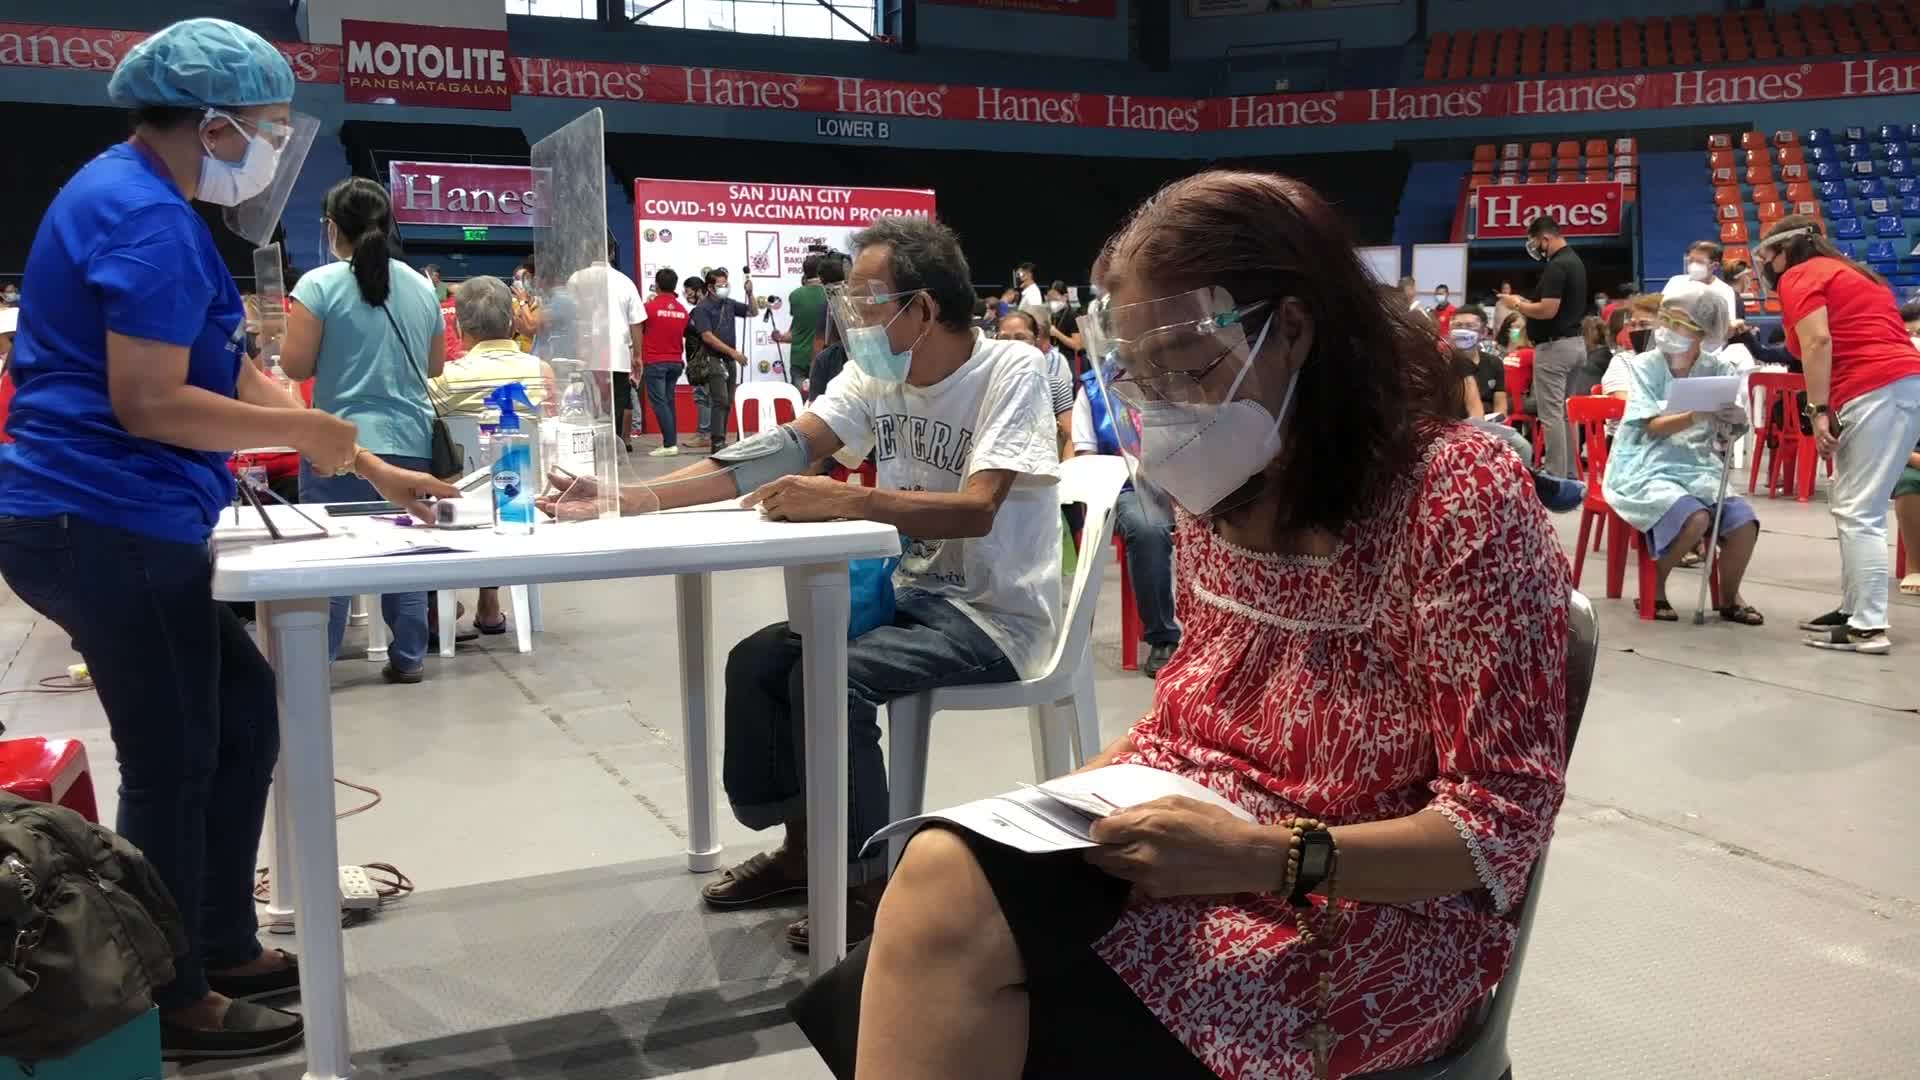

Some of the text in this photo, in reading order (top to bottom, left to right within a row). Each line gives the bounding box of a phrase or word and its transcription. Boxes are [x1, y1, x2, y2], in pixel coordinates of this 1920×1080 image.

[348, 39, 507, 83] MOTOLITE
[349, 77, 509, 96] PANGMATAGALAN
[517, 57, 644, 100] Hanes
[682, 66, 799, 110] Hanes
[1672, 70, 1803, 106] Hanes
[833, 76, 942, 118] Hanes
[975, 86, 1075, 124] Hanes
[1104, 95, 1200, 132] Hanes
[1226, 96, 1337, 128] Hanes
[1367, 88, 1482, 121] Hanes
[1515, 80, 1636, 114] Hanes
[817, 118, 889, 138] LOWER B
[401, 173, 540, 216] Hanes
[644, 200, 726, 217] COVID-19
[730, 203, 845, 220] VACCINATION
[729, 186, 852, 203] SAN JUAN CITY
[1483, 195, 1607, 227] Hanes
[783, 246, 800, 254] SAN
